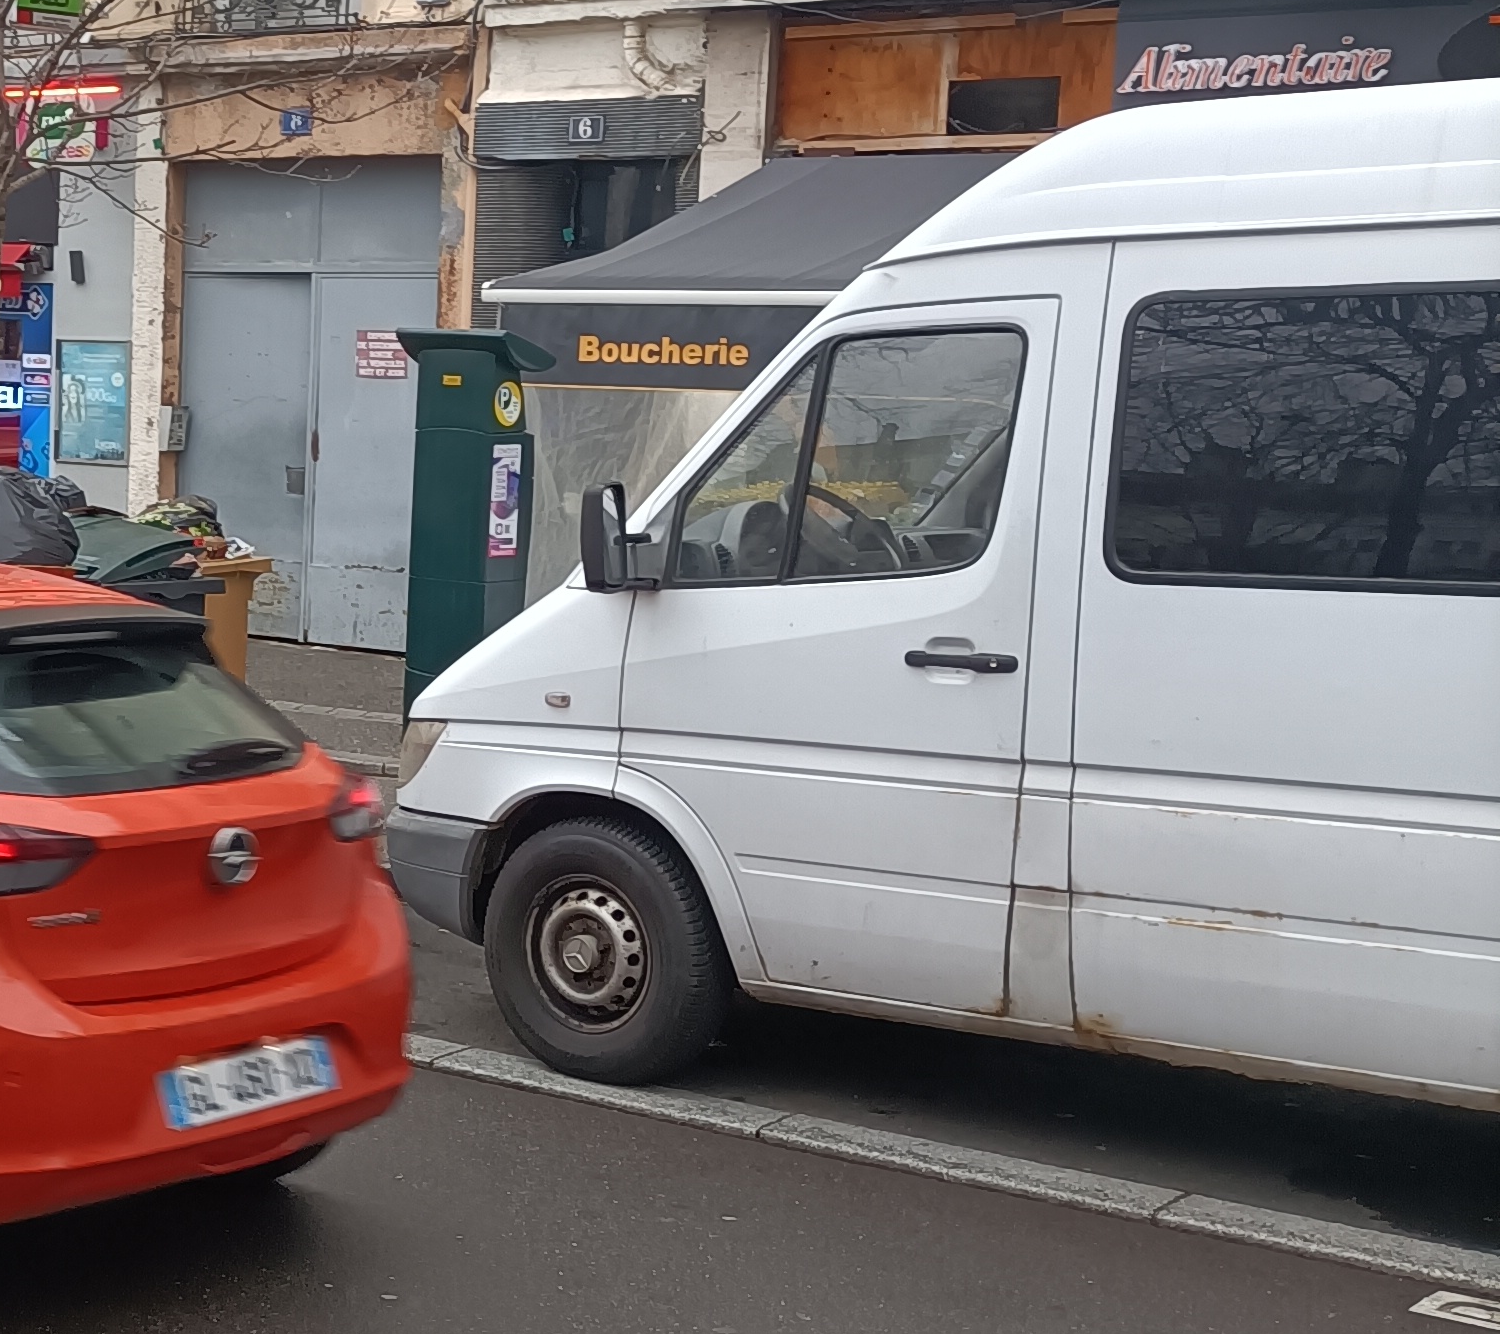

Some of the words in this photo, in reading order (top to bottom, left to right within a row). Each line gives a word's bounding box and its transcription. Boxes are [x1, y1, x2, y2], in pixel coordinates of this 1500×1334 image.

[1116, 36, 1392, 93] Alimentaire
[579, 117, 592, 138] 6
[578, 335, 749, 366] Boucherie
